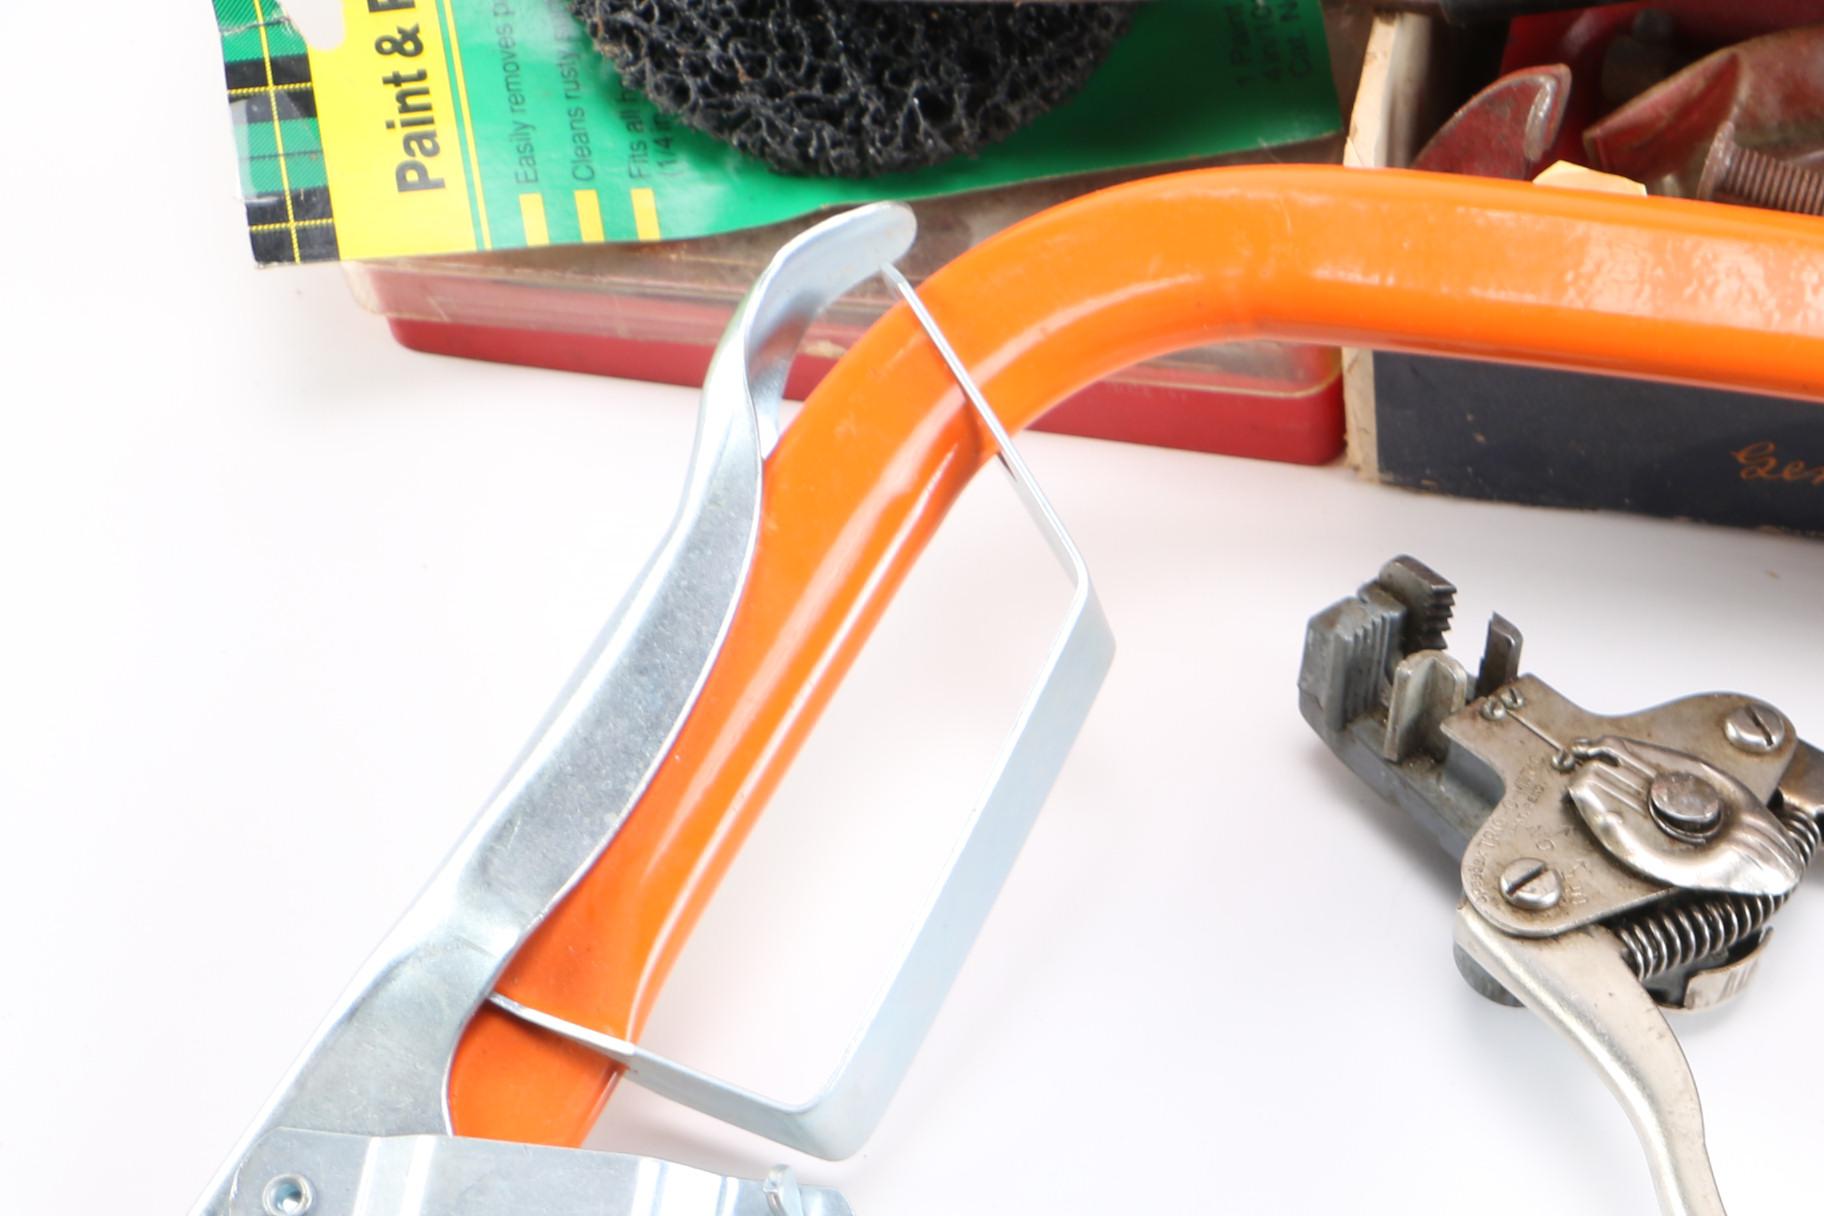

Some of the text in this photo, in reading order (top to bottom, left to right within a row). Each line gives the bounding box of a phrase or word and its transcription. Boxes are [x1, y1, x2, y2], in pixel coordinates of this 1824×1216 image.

[374, 23, 424, 58] &
[499, 23, 526, 114] removes
[558, 50, 581, 100] rusty
[382, 69, 446, 193] Paint
[569, 106, 596, 182] Cleans
[618, 106, 644, 134] all
[512, 120, 538, 184] Easily
[627, 140, 650, 179] Fits
